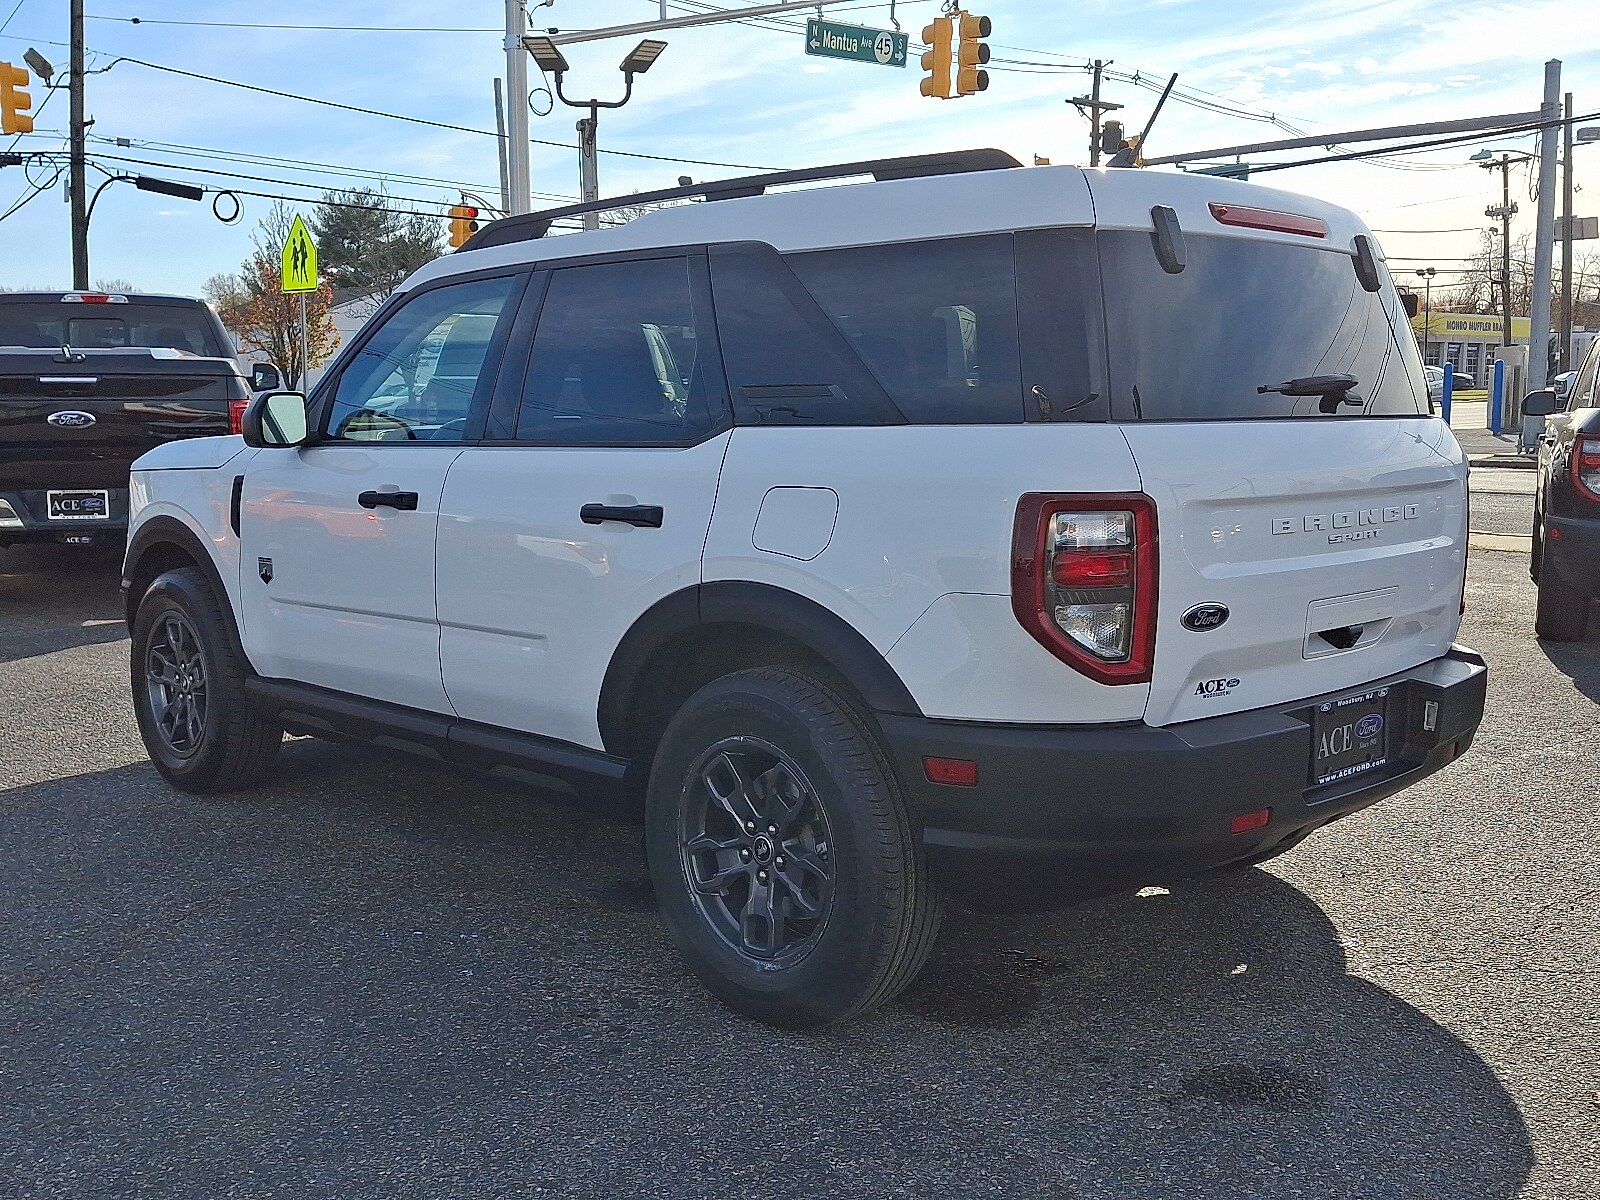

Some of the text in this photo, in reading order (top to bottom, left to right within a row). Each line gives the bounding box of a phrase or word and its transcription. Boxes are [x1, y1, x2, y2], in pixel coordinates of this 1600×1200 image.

[812, 24, 819, 37] N
[822, 29, 873, 53] Mantua Ave
[875, 37, 891, 56] 45
[897, 38, 903, 50] S
[1446, 320, 1504, 332] MONRO MUFFLER BRA
[52, 499, 80, 511] ACE
[1271, 503, 1420, 536] BRONCO
[1327, 528, 1384, 544] SPORT
[1193, 678, 1227, 695] ACE
[1317, 723, 1353, 760] ACE
[1318, 758, 1386, 785] www.ACEFORD.com
